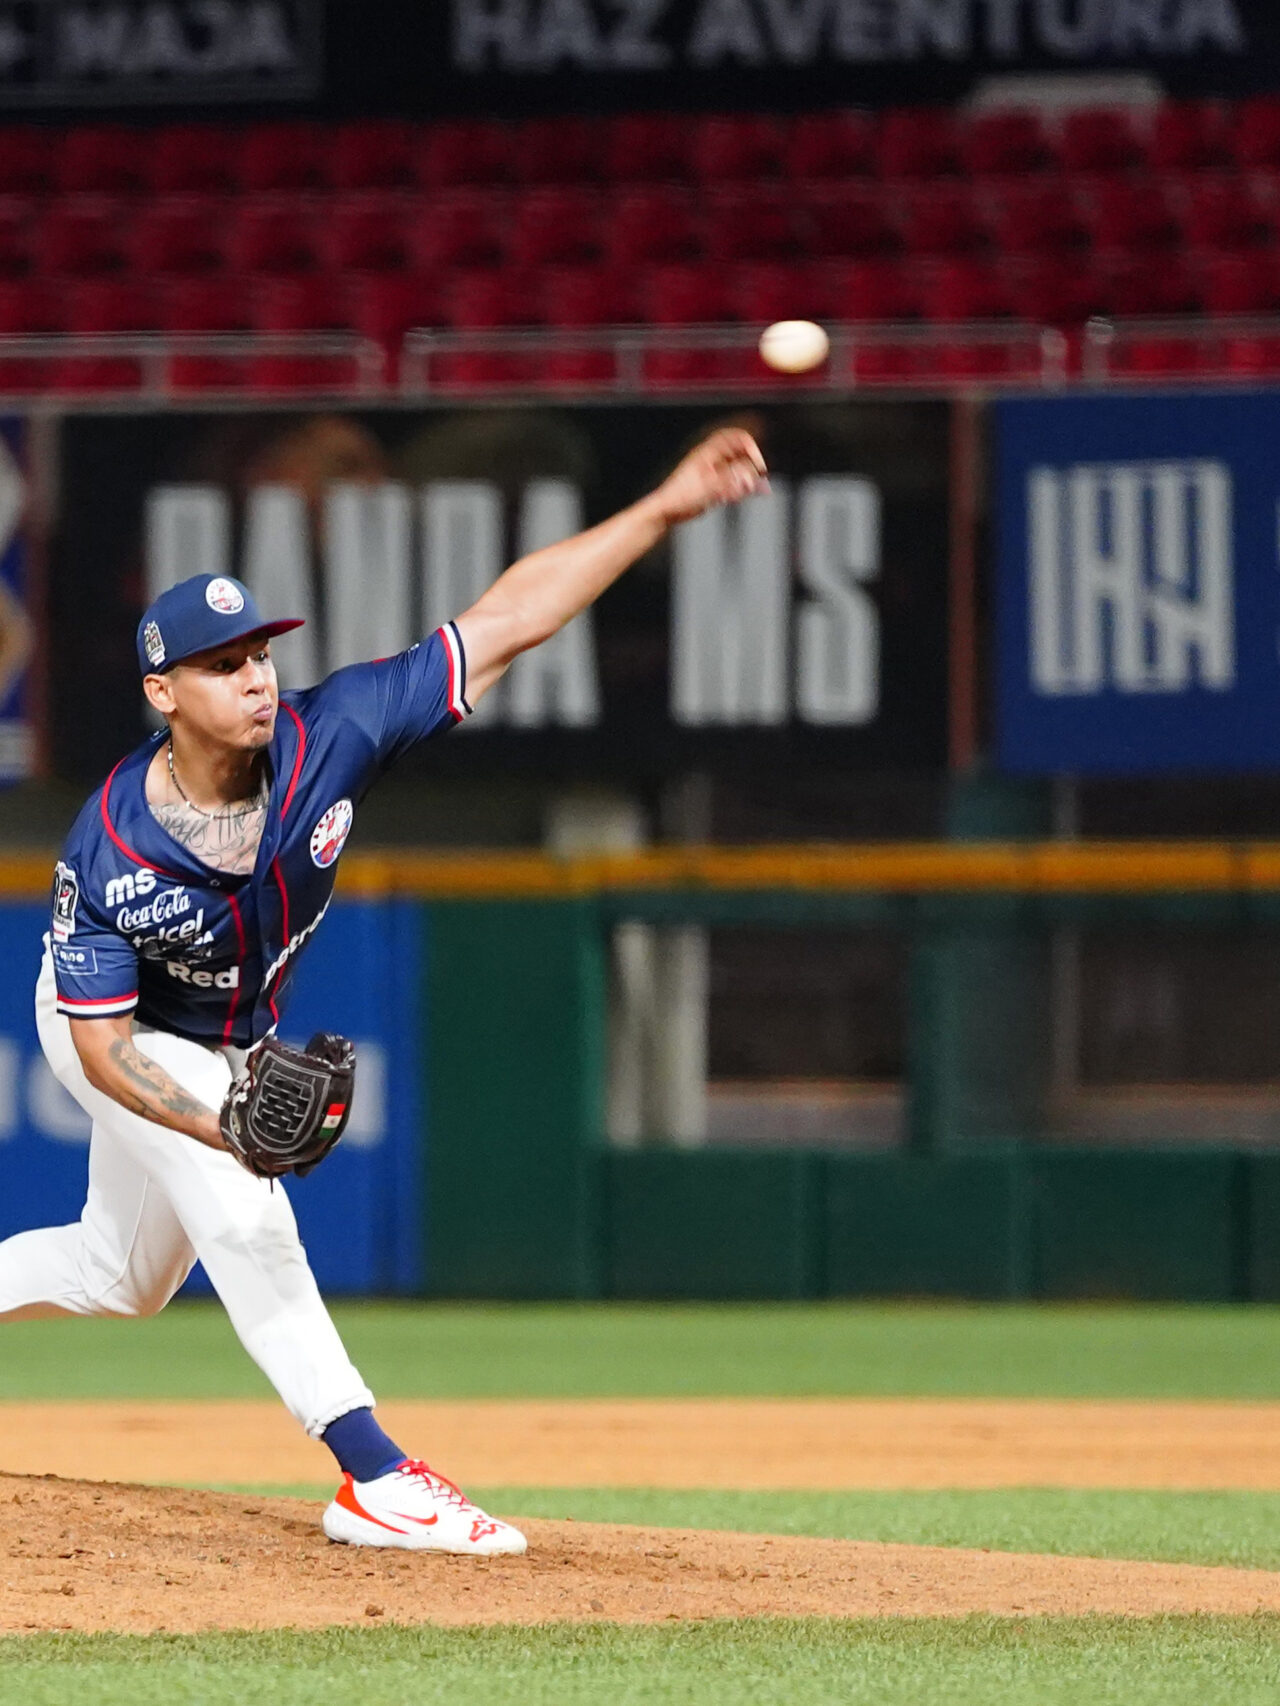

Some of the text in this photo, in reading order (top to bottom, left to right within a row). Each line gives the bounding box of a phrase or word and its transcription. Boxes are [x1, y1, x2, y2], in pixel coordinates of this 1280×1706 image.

[452, 0, 1248, 70] HAZ AVENTURA
[670, 474, 882, 726] MS
[167, 961, 239, 988] Red
